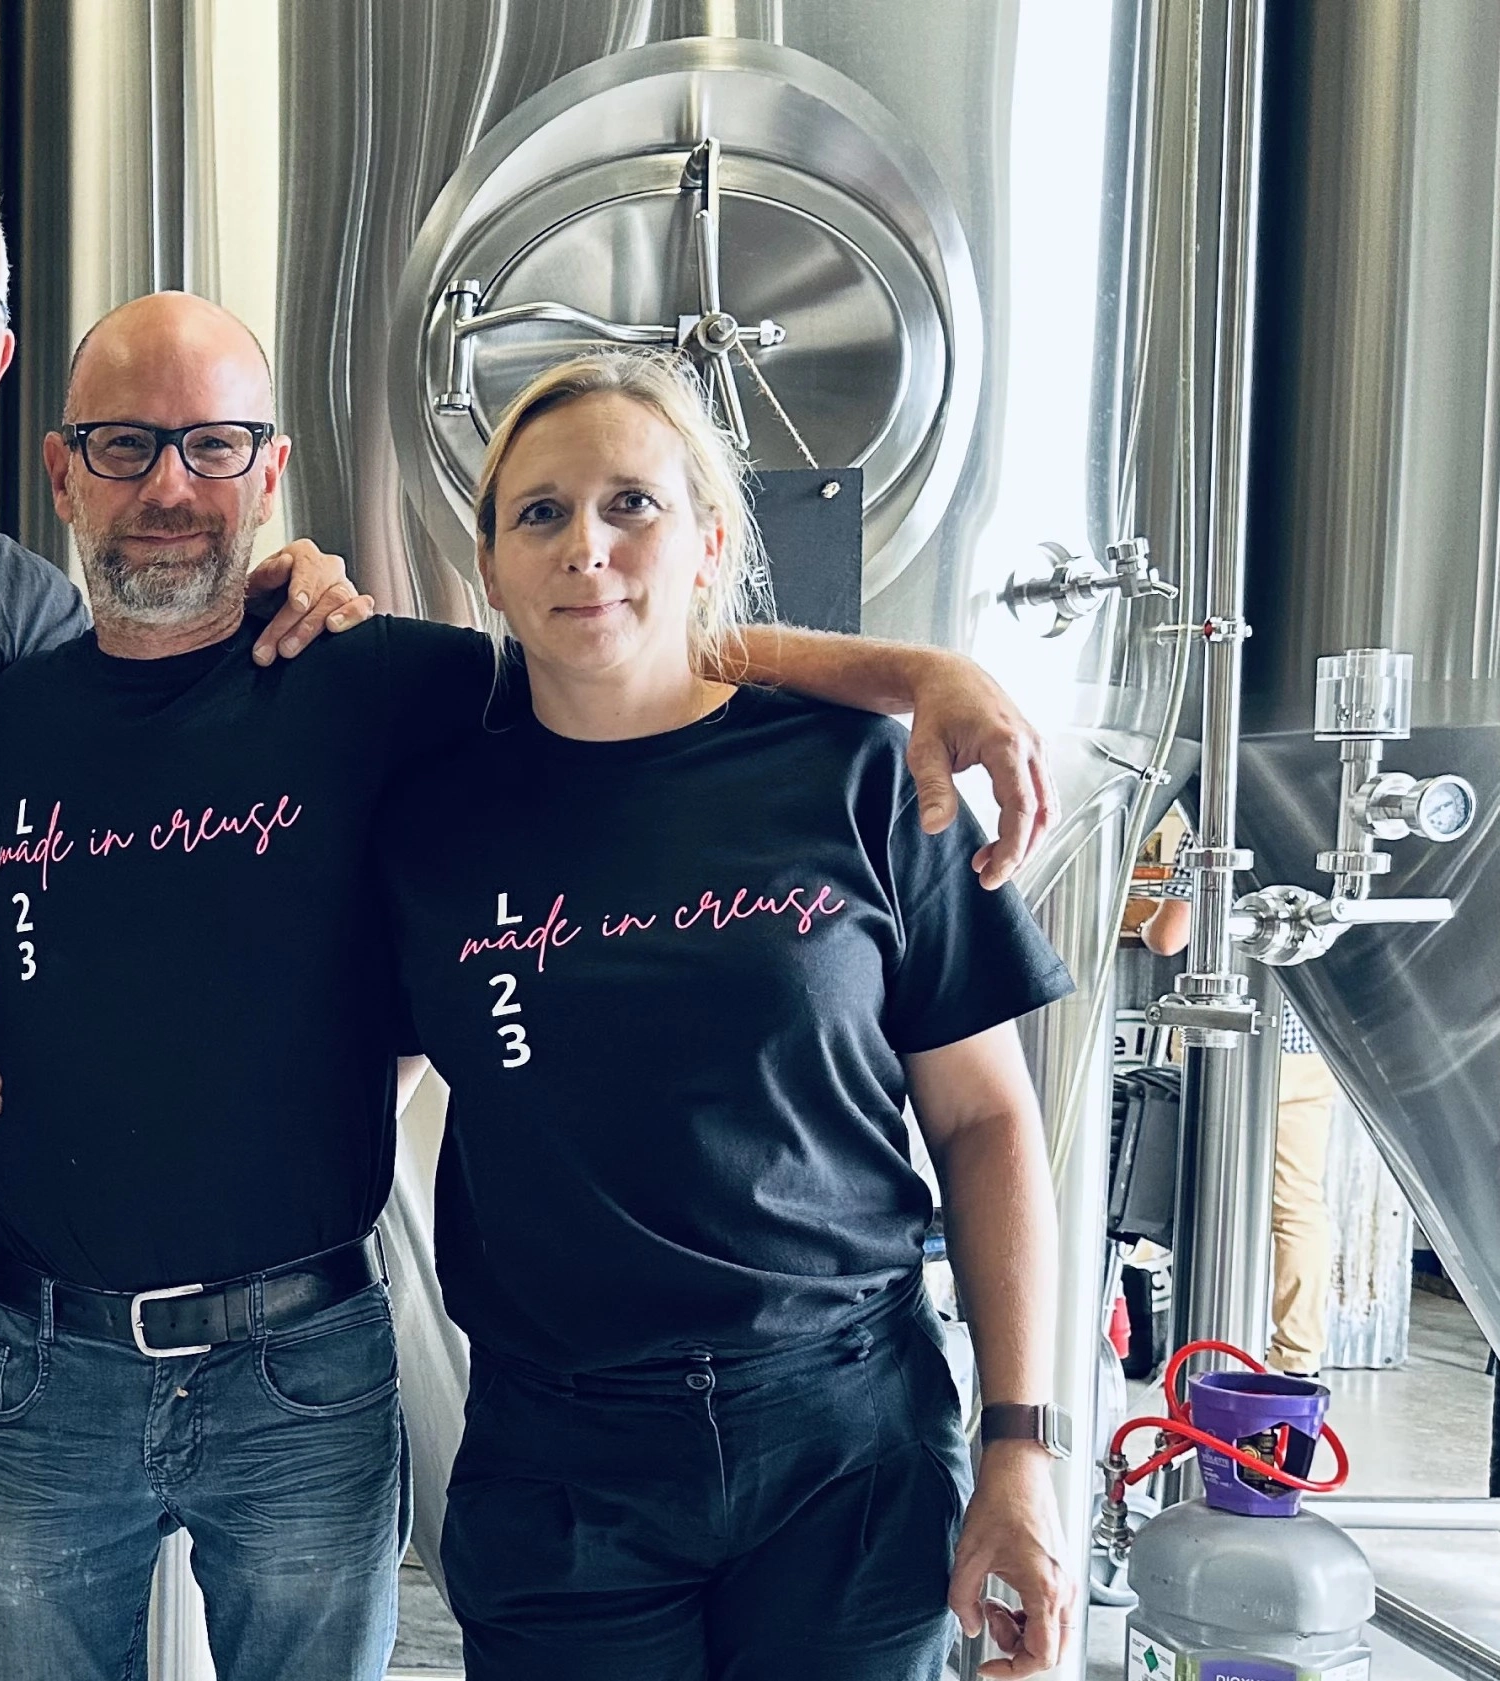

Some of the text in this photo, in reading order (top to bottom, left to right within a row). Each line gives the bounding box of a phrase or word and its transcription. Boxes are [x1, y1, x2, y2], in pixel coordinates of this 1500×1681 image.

[16, 798, 33, 835] L
[89, 828, 135, 857] in
[150, 794, 302, 855] creuse
[459, 884, 846, 973] made in creuse
[496, 892, 523, 926] L
